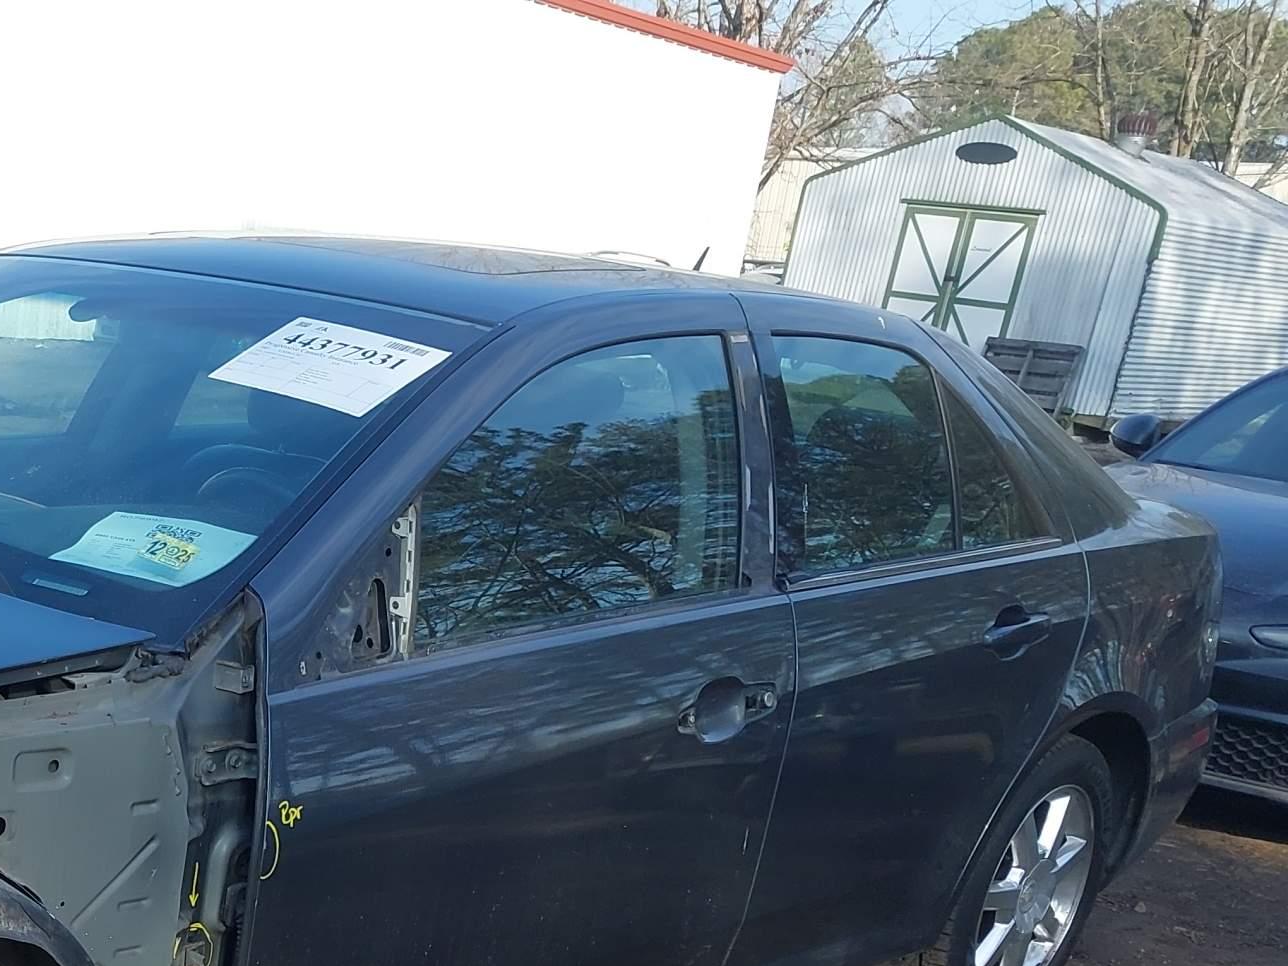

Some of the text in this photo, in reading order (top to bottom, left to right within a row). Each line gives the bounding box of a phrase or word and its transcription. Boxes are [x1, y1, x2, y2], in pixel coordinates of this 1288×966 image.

[283, 333, 409, 370] 44377931
[145, 540, 168, 556] 12
[174, 549, 195, 563] 25
